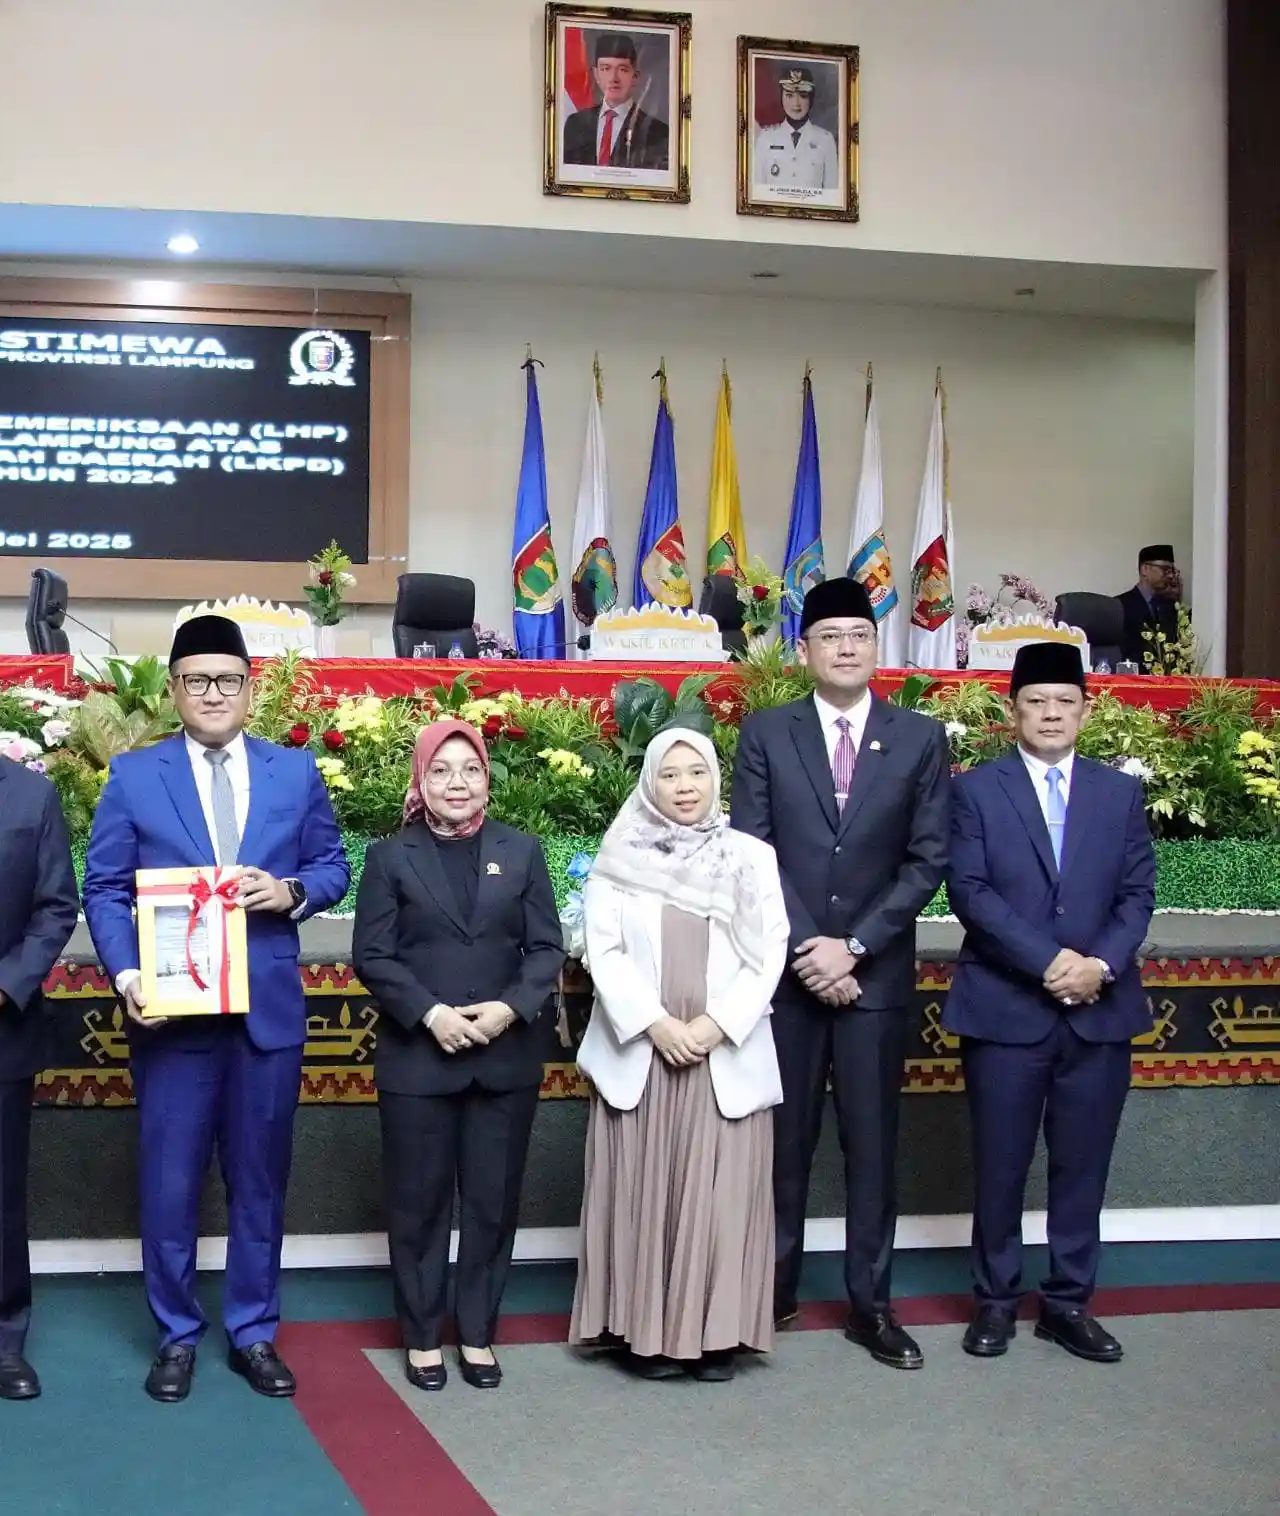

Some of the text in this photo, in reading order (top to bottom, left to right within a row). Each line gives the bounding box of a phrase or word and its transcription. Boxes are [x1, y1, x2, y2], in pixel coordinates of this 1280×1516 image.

[129, 355, 255, 371] LAMPUNG
[250, 422, 349, 443] (LHP)
[187, 438, 282, 454] ATAS
[57, 452, 211, 469] DAERAH
[221, 455, 346, 476] (LKPD)
[87, 469, 178, 486] 2024
[47, 532, 133, 550] 2025
